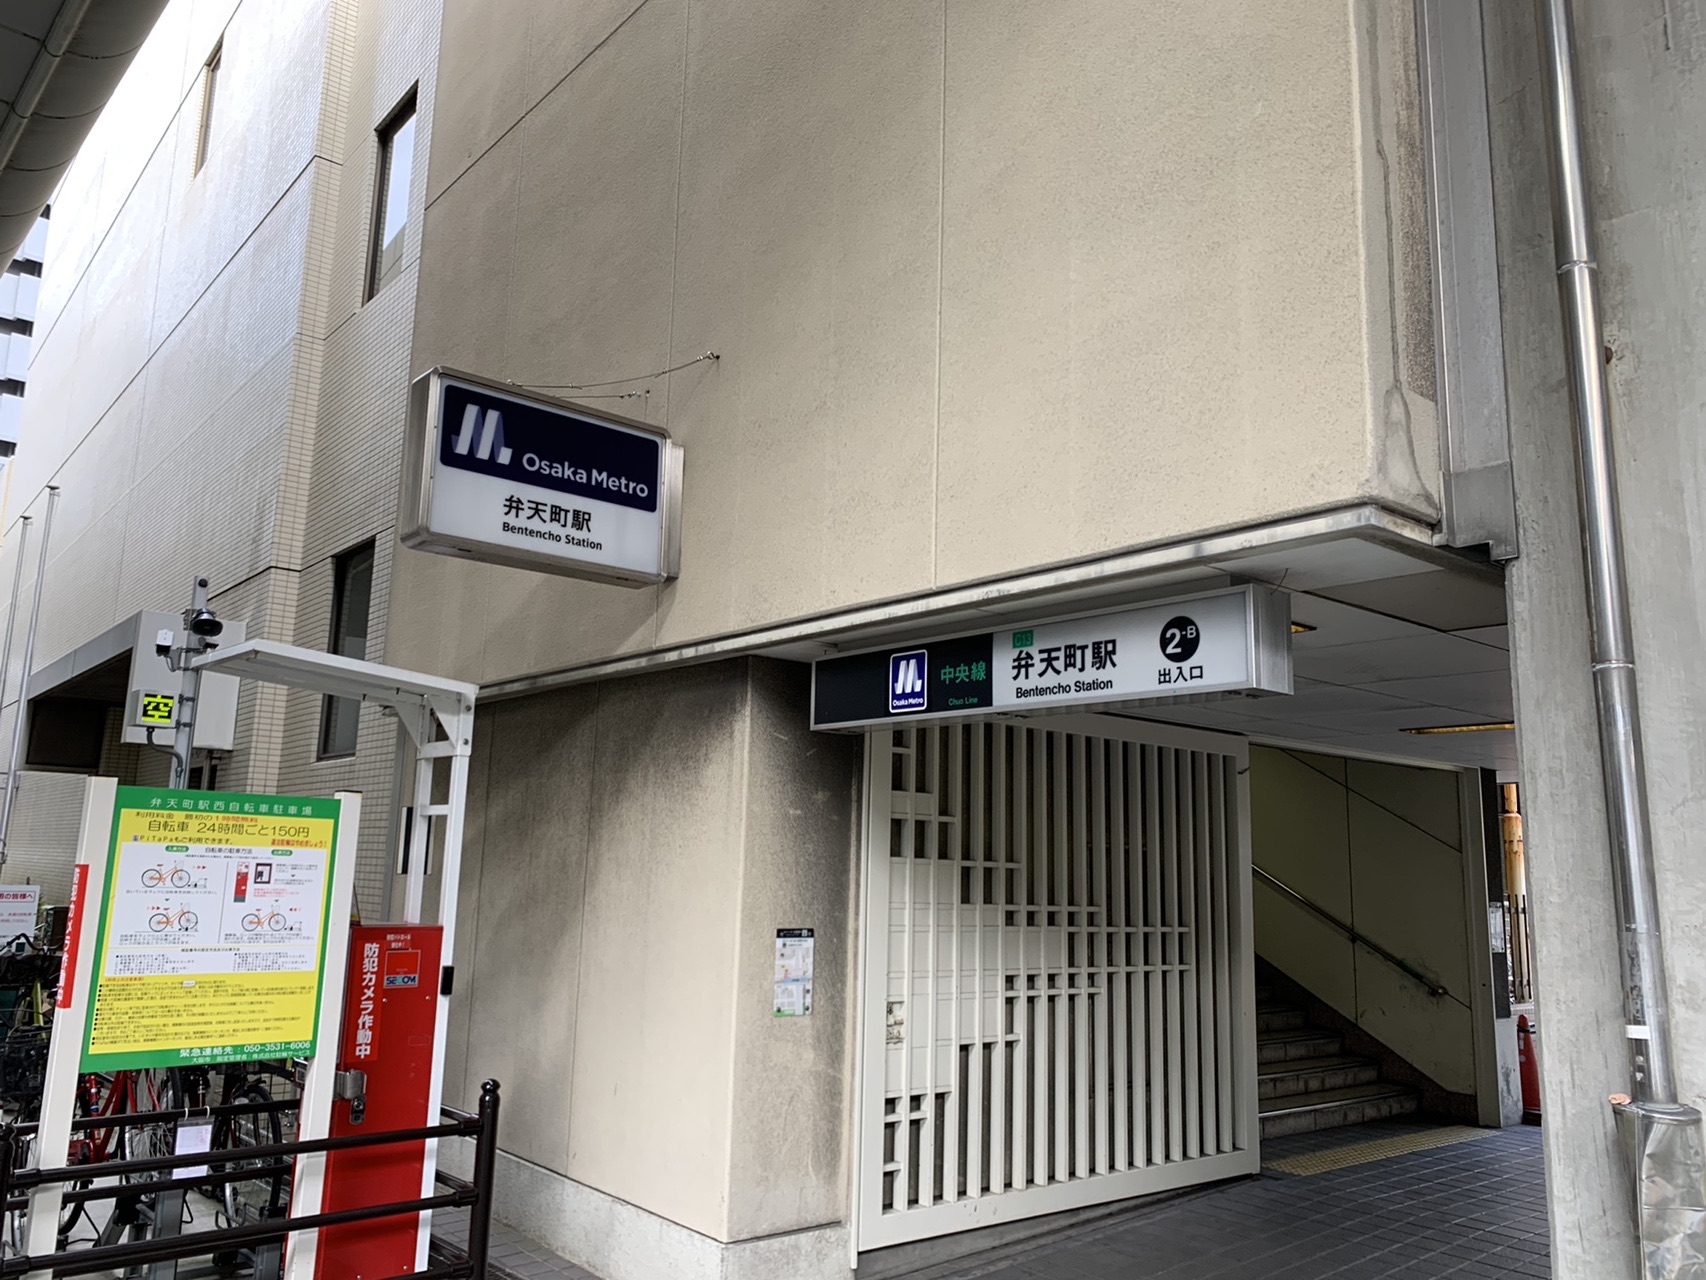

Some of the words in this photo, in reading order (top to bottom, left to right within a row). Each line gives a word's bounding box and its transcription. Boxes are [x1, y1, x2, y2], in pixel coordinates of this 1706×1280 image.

[522, 453, 587, 483] Osaka
[591, 468, 649, 498] Metro
[503, 494, 592, 533] 弁天町駅
[502, 522, 562, 543] Bentencho
[565, 534, 603, 551] Station
[1014, 633, 1032, 647] C13
[1011, 639, 1117, 681] 弁天町駅
[940, 660, 986, 685] 中央線
[1158, 665, 1203, 685] 出入口
[1016, 682, 1071, 699] Bentencho
[1074, 678, 1113, 693] Station
[892, 698, 908, 706] Osaka
[908, 697, 924, 705] Metro
[948, 697, 964, 706] Chuo
[965, 696, 979, 704] Line
[150, 797, 313, 816] 弁天町駅西自転車駐車場
[148, 819, 190, 833] 自転車
[197, 822, 310, 838] 24時間ごと150円
[386, 975, 417, 985] SECOM
[355, 942, 380, 1059] 防犯カメラ作動中
